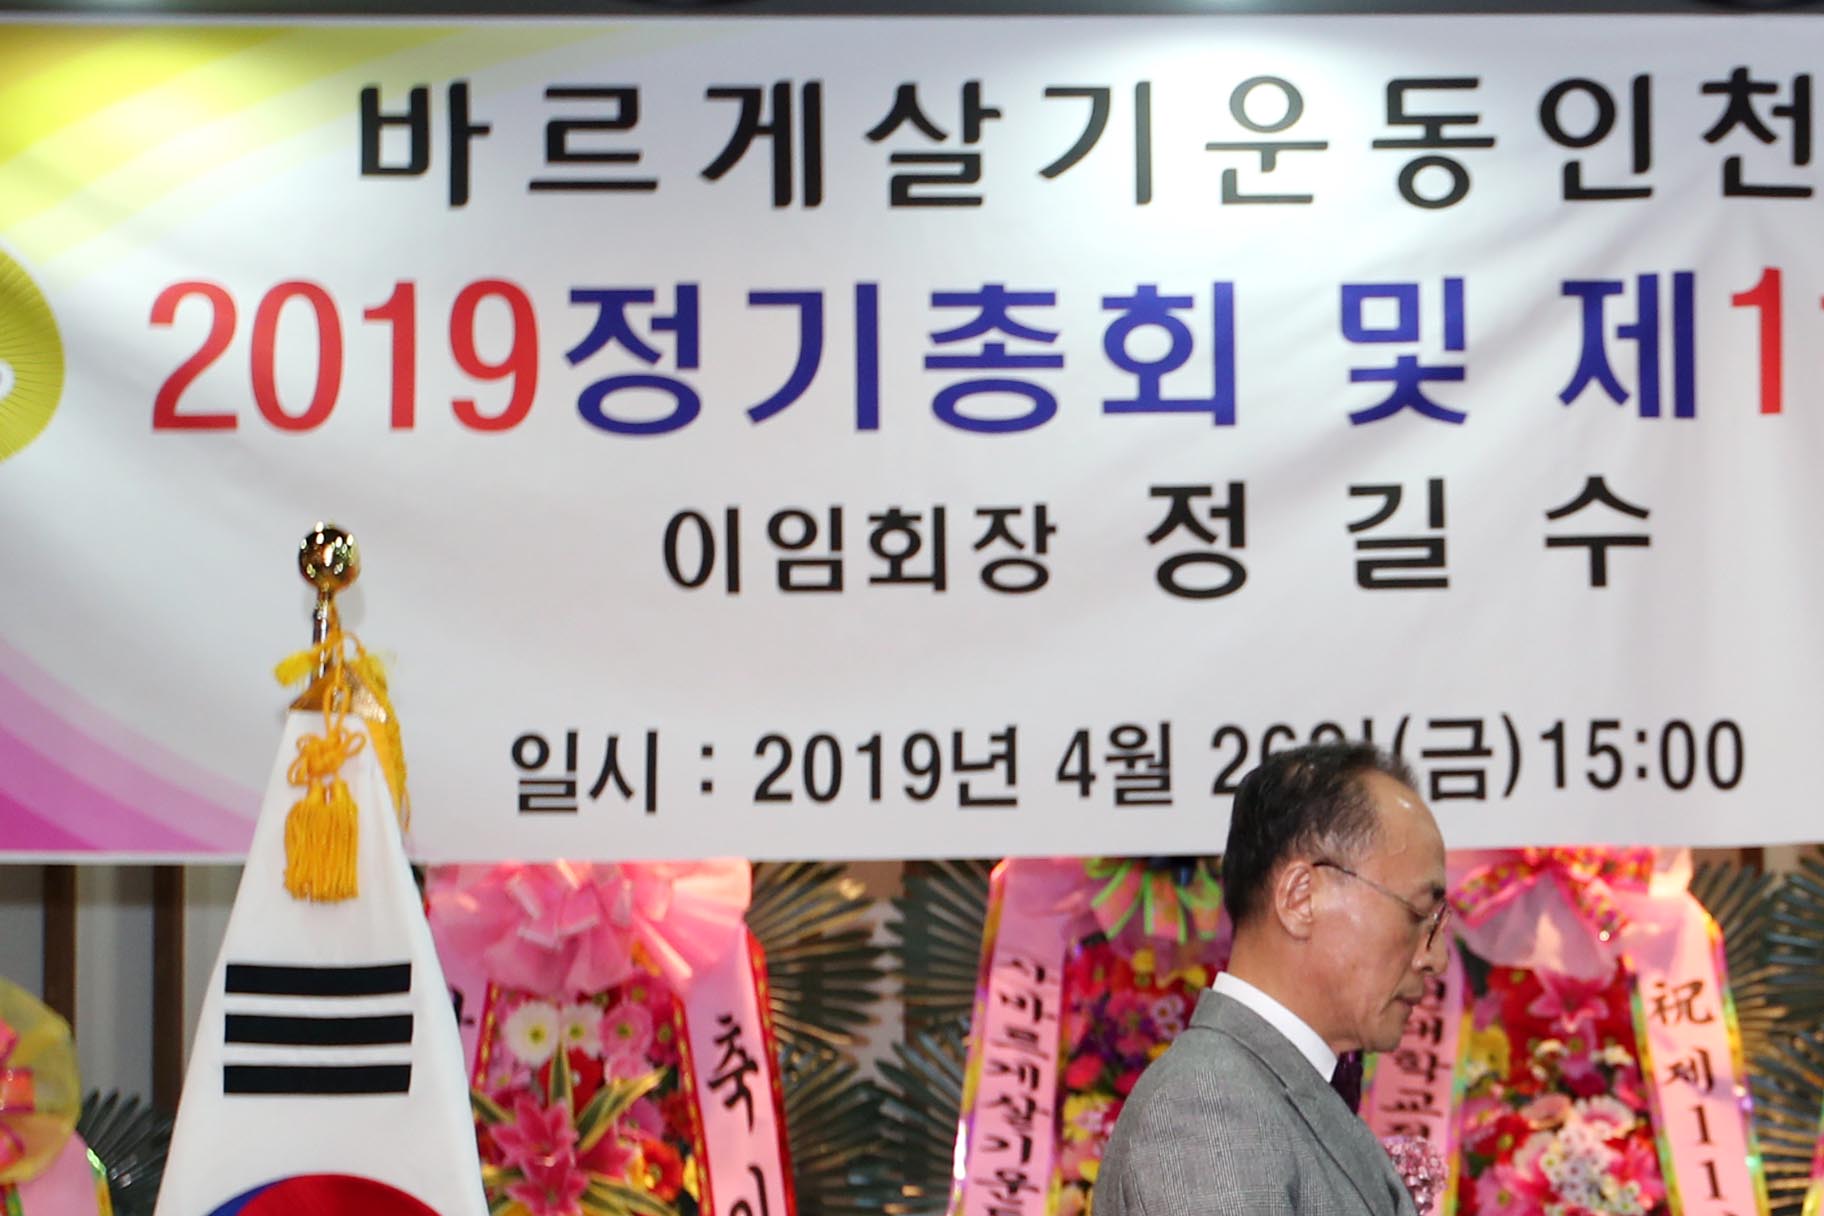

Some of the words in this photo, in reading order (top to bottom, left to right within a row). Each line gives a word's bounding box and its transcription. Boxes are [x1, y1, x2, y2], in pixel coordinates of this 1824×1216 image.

[150, 279, 1236, 436] 2019정기총회
[1340, 277, 1467, 426] 및
[662, 504, 1057, 594] 이임회장
[511, 730, 658, 813] 일시
[754, 726, 1018, 807] 2019년
[1057, 722, 1174, 806] 4월
